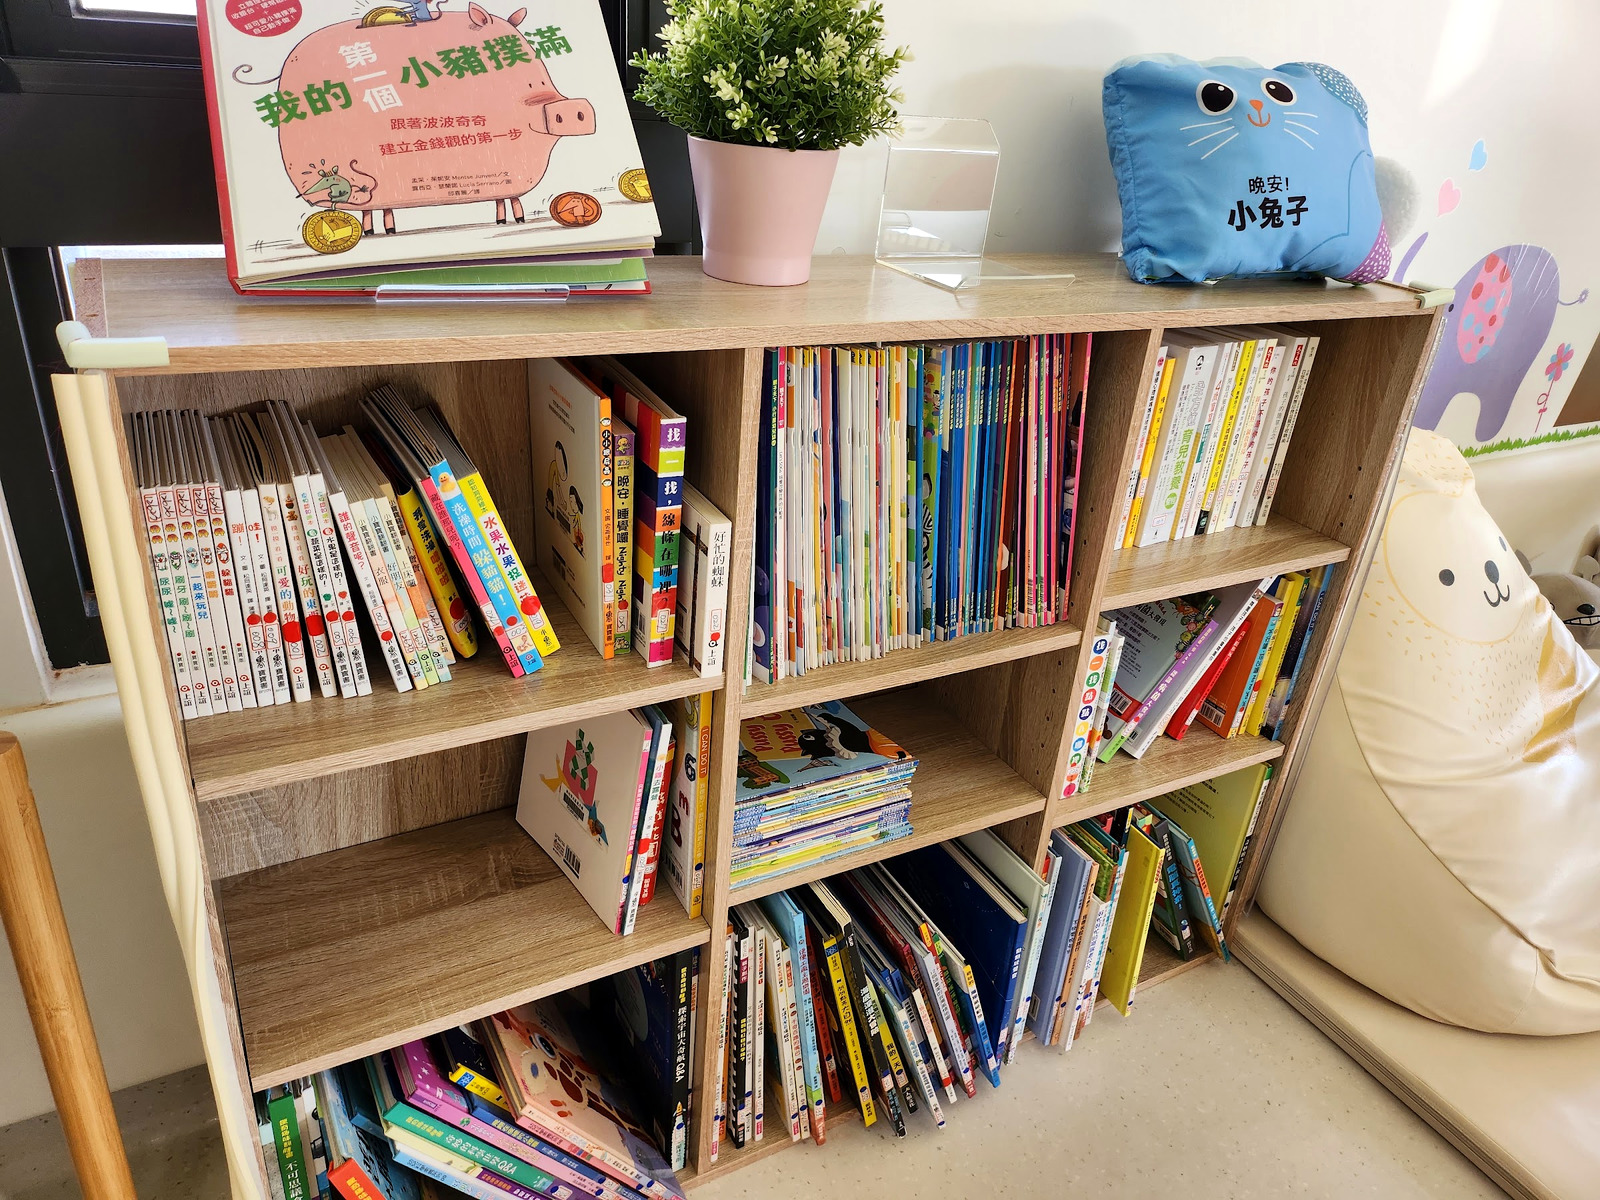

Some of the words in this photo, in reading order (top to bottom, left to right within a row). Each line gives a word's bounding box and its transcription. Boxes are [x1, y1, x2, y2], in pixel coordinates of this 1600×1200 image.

[253, 79, 353, 128] 我的
[338, 40, 404, 113] 第一個
[399, 25, 573, 89] 小豬撲滿
[390, 114, 487, 131] 跟著波波奇奇
[379, 127, 523, 157] 建立金錢觀的第一步
[1248, 174, 1290, 195] 晚安!
[1227, 195, 1309, 232] 小兔子
[1242, 366, 1277, 469] 你的孩子不是你的孩子
[1169, 428, 1194, 491] 育兒教養
[337, 511, 365, 570] 誰的聲音呢?
[451, 502, 482, 549] 洗澡時間
[472, 548, 506, 606] 躲貓貓!
[616, 546, 627, 576] Nighty
[711, 531, 726, 588] 好忙的蜘蛛
[375, 566, 388, 586] 衣服
[387, 563, 404, 590] 好朋友
[615, 580, 627, 602] Nigh
[276, 565, 296, 622] 可愛的動物
[701, 733, 709, 751] CAN
[746, 724, 774, 753] Pussy
[772, 723, 803, 753] Pussy
[700, 753, 708, 766] DO
[885, 1042, 901, 1070] 我的一天
